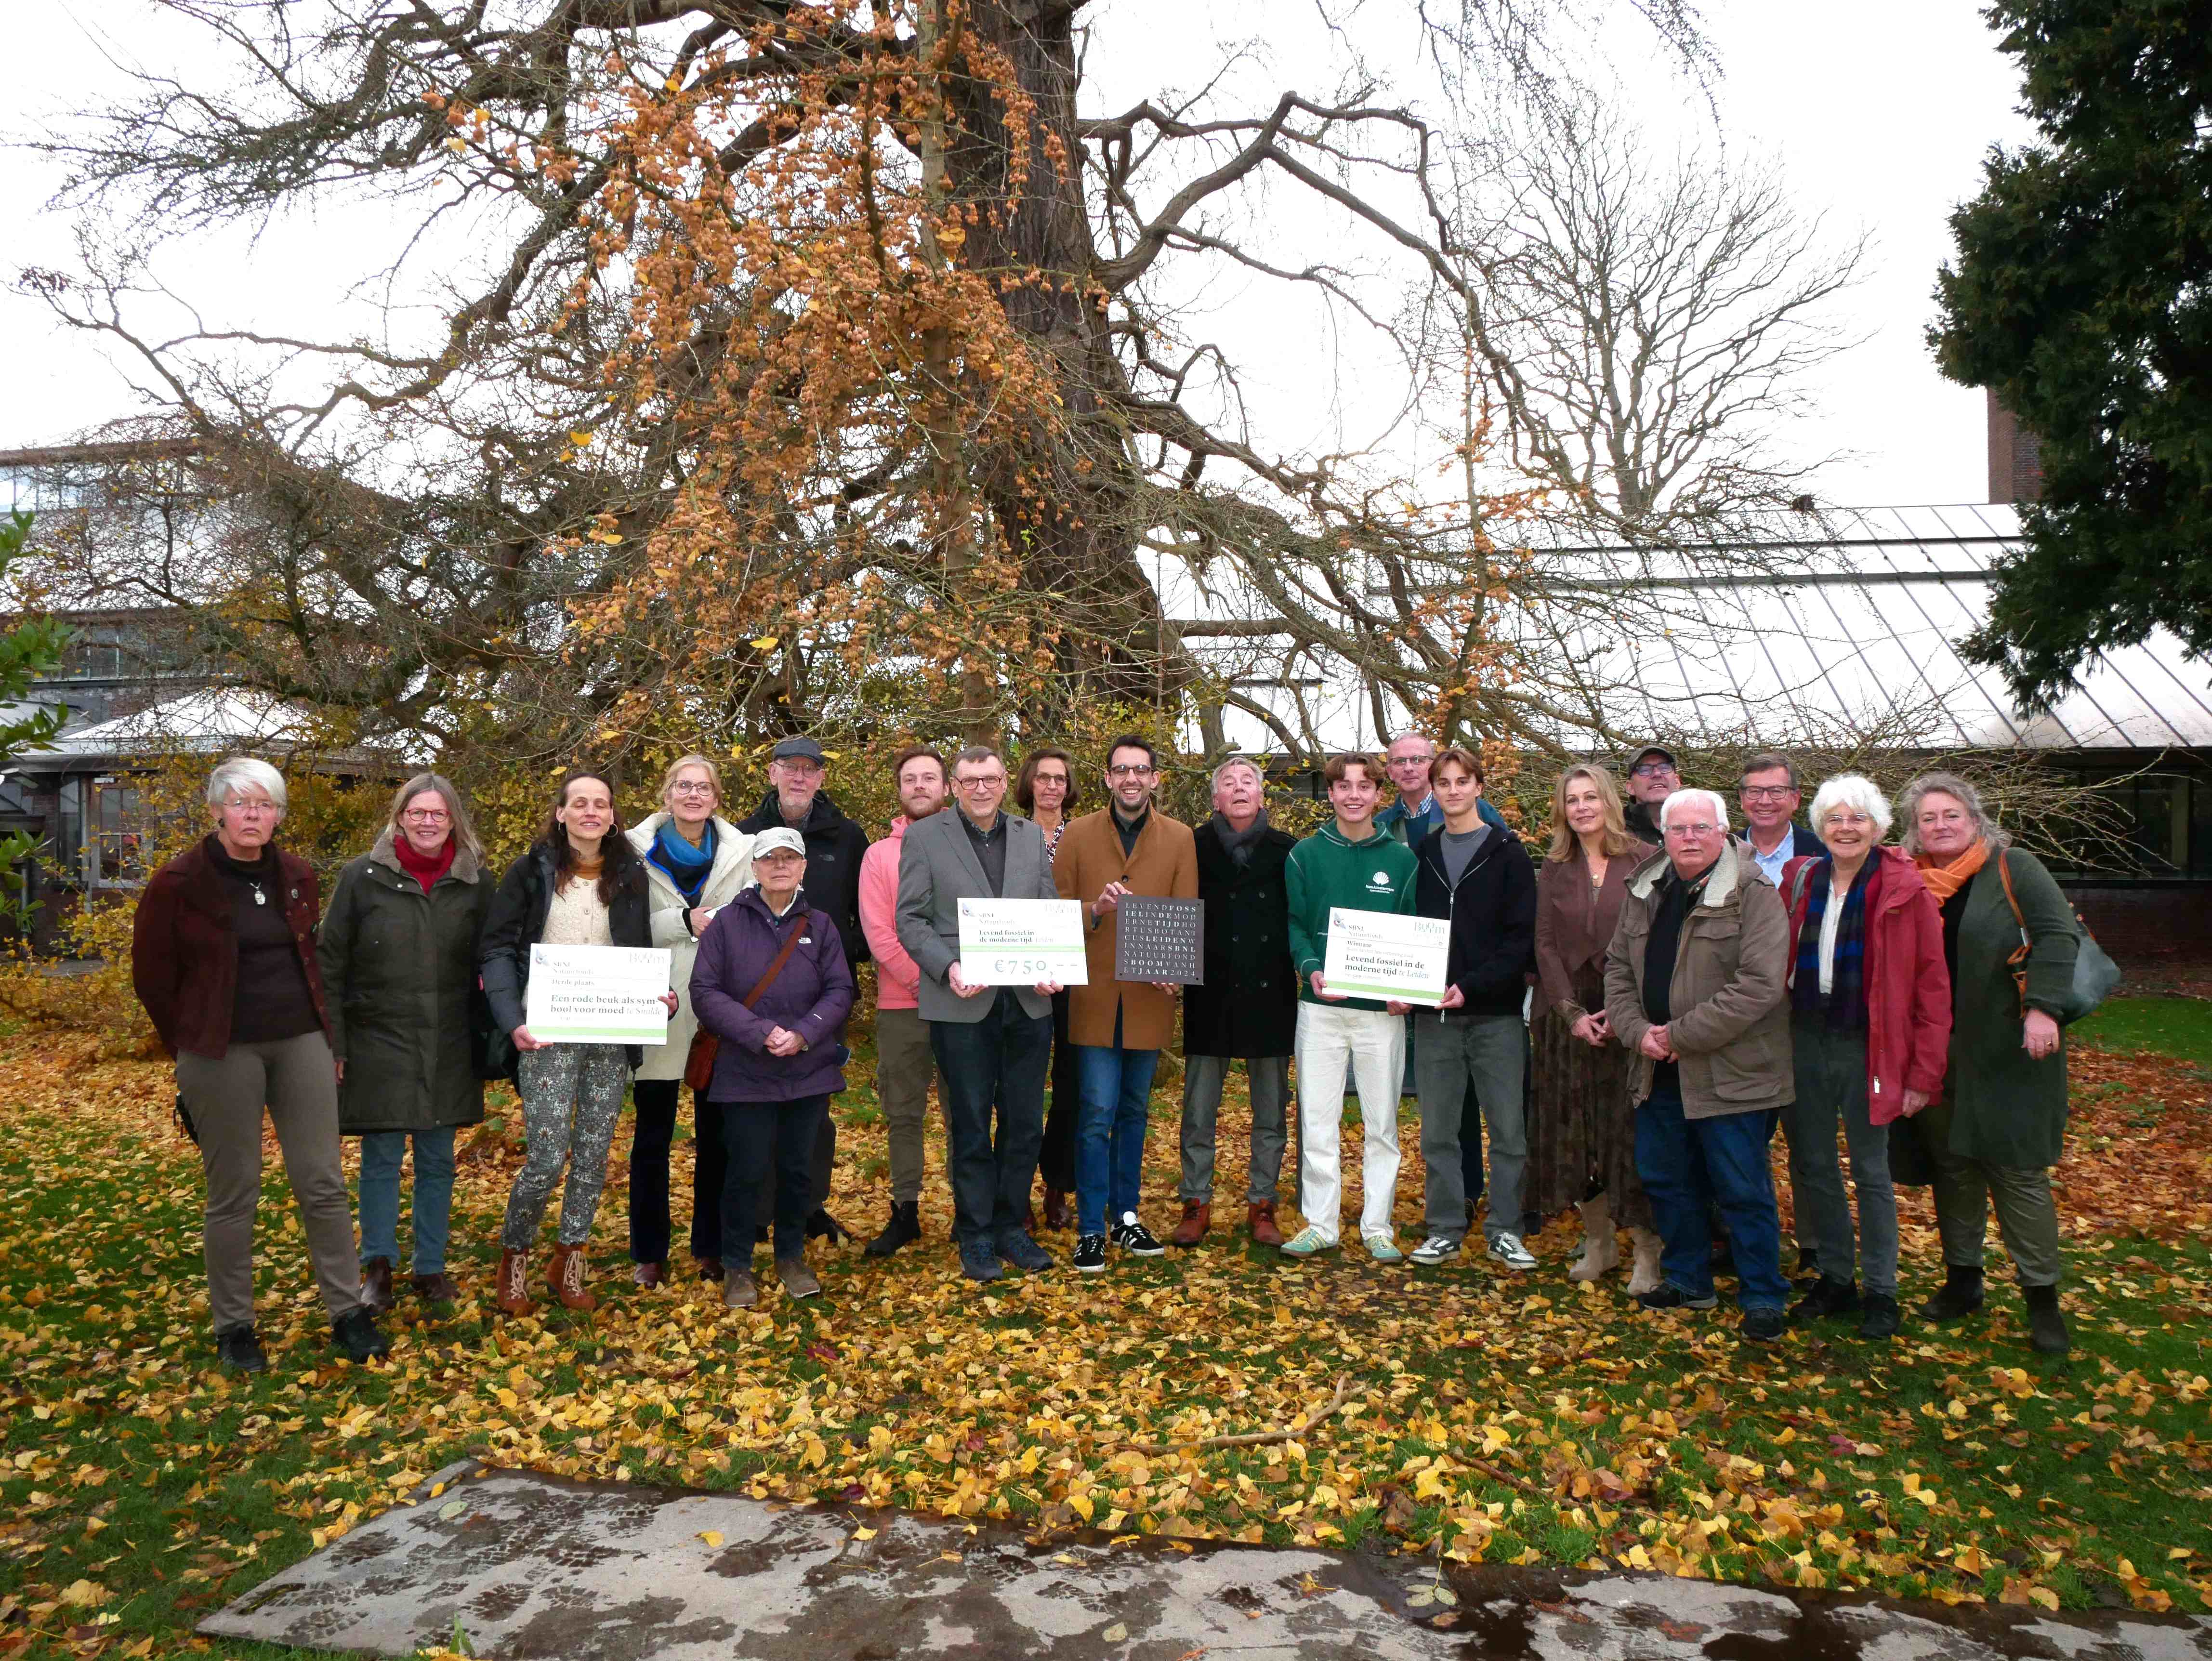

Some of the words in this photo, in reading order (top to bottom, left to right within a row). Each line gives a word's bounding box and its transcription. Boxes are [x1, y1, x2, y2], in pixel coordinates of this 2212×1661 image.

[1346, 954, 1374, 963] Levend
[1377, 957, 1402, 966] fossiel
[1345, 963, 1381, 974] moderne
[1383, 968, 1397, 976] tijd
[1407, 970, 1430, 978] Leiden
[572, 995, 594, 1003] rode
[596, 995, 619, 1003] beuk
[621, 996, 634, 1004] als
[598, 1006, 624, 1014] moed
